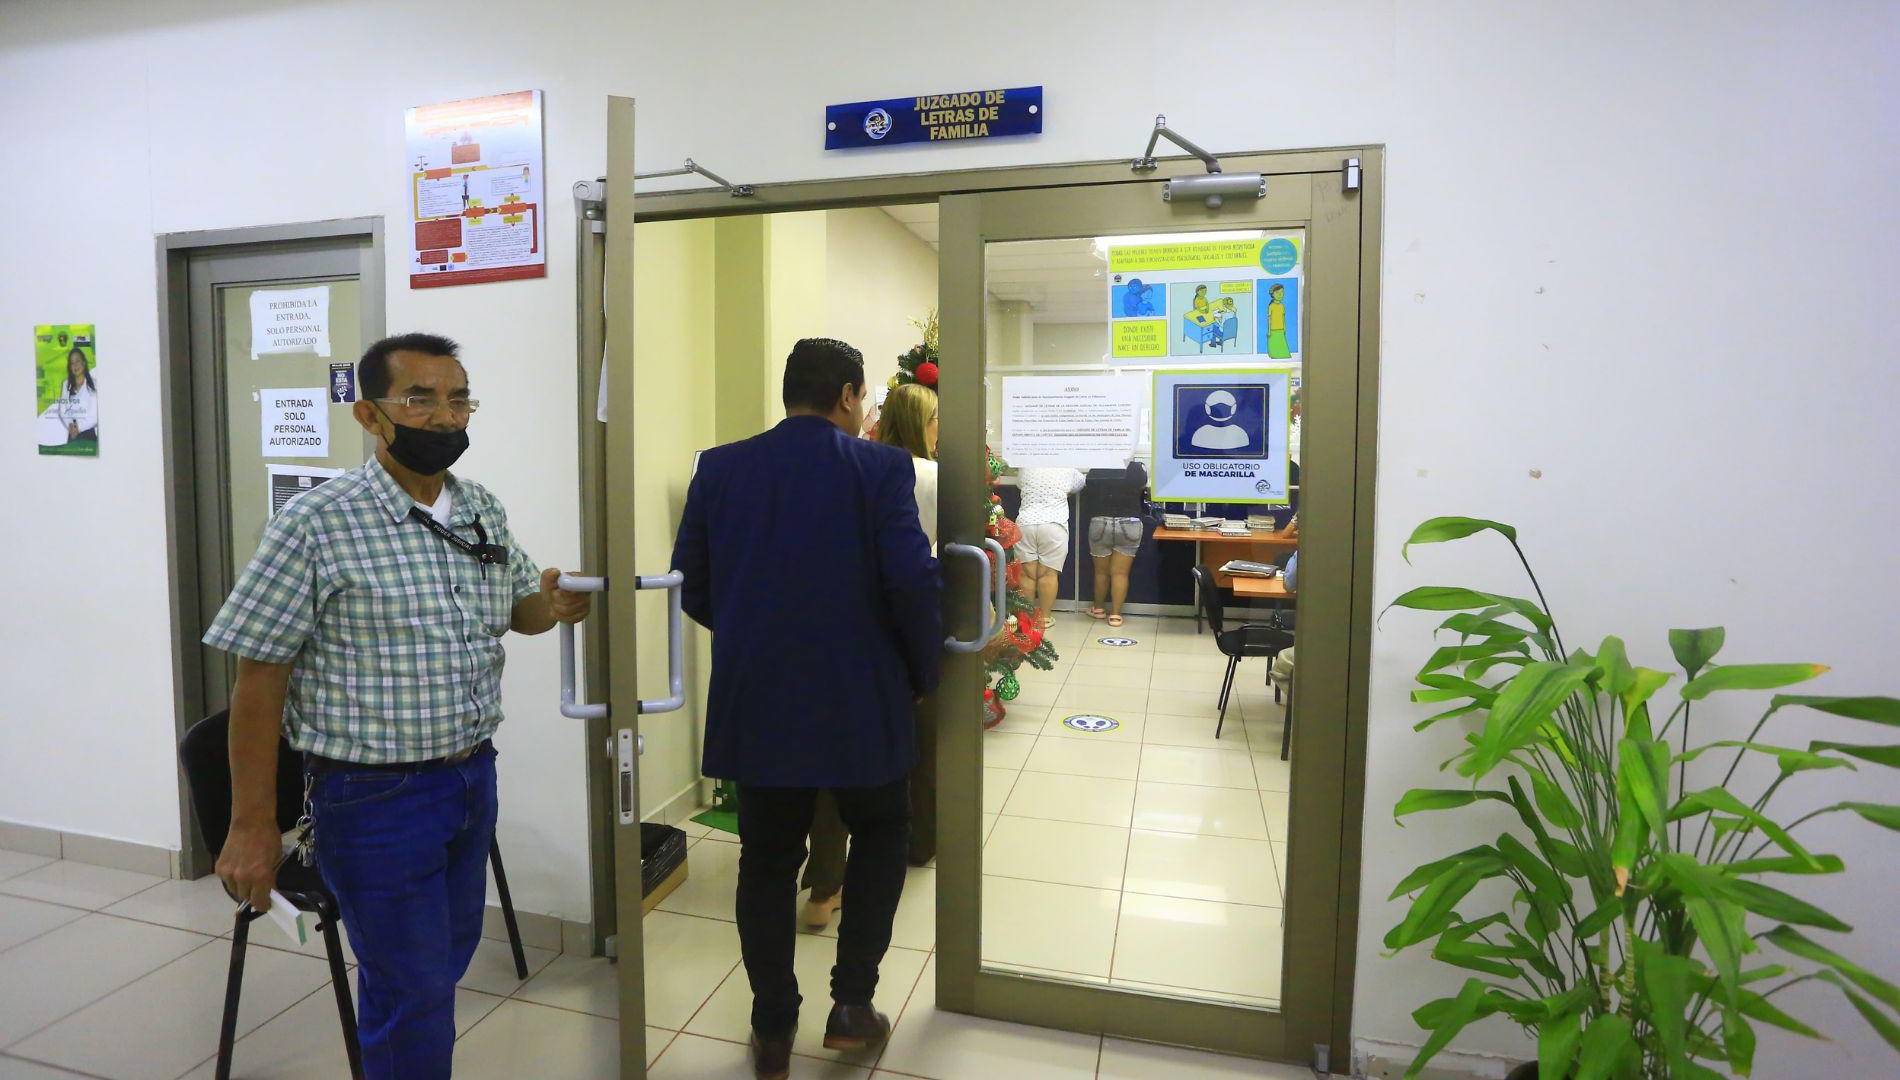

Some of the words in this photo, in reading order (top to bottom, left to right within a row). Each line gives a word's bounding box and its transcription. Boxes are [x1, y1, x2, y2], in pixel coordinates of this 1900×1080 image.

[913, 91, 981, 111] JUZGADO
[985, 90, 1005, 104] DE
[920, 108, 974, 126] LETRAS
[978, 107, 998, 120] DE
[930, 123, 989, 140] FAMILIA
[269, 300, 307, 310] PROHIBIDA
[266, 327, 285, 335] SOLO
[286, 325, 322, 334] PERSONAL
[272, 337, 317, 346] AUTORIZADO
[276, 400, 313, 408] ENTRADA
[284, 412, 305, 420] SOLO
[274, 425, 316, 433] PERSONAL
[270, 437, 322, 446] AUTORIZADO
[434, 524, 450, 538] PODER
[451, 536, 472, 550] JUDICIAL
